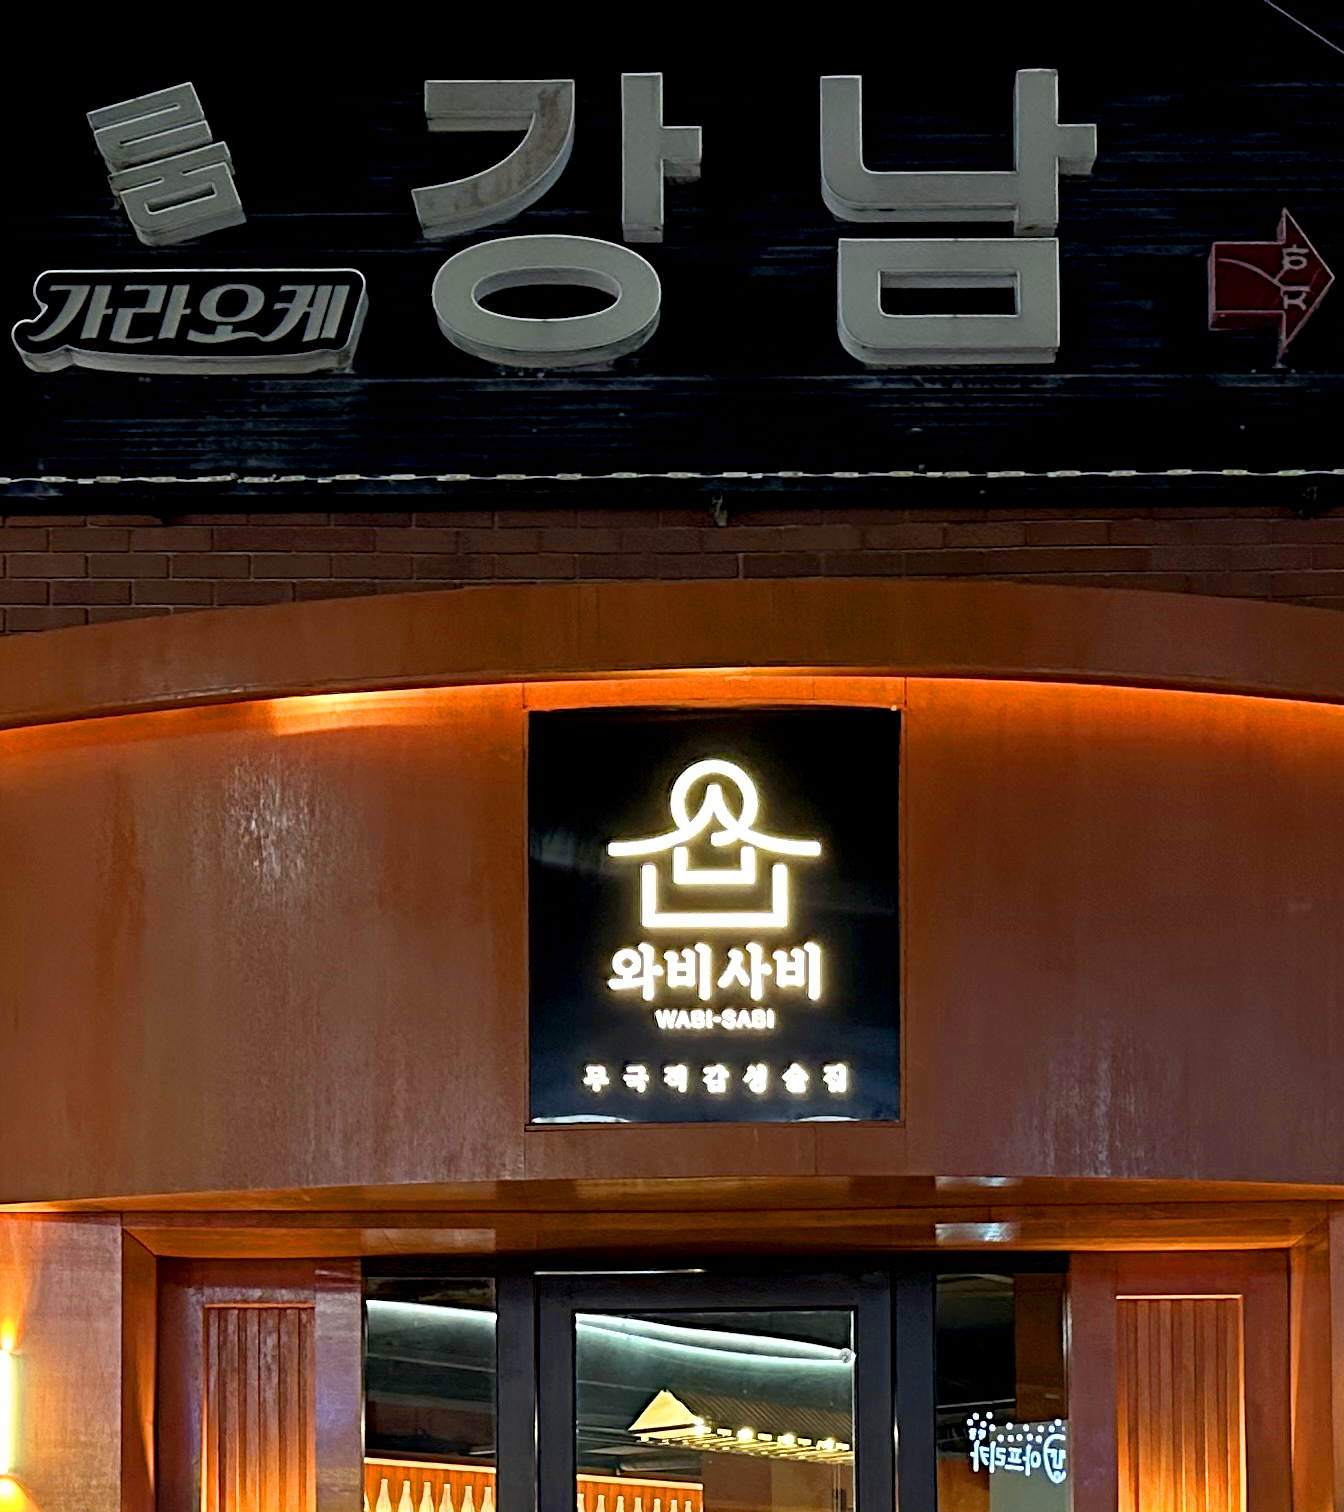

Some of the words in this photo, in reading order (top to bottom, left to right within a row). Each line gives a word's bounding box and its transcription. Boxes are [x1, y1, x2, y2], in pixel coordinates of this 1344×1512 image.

[86, 82, 247, 247] 룸
[411, 69, 1098, 366] 강남
[27, 282, 351, 345] 가라오케
[607, 941, 822, 1001] 와비사비
[655, 1008, 775, 1030] WABI-SABI
